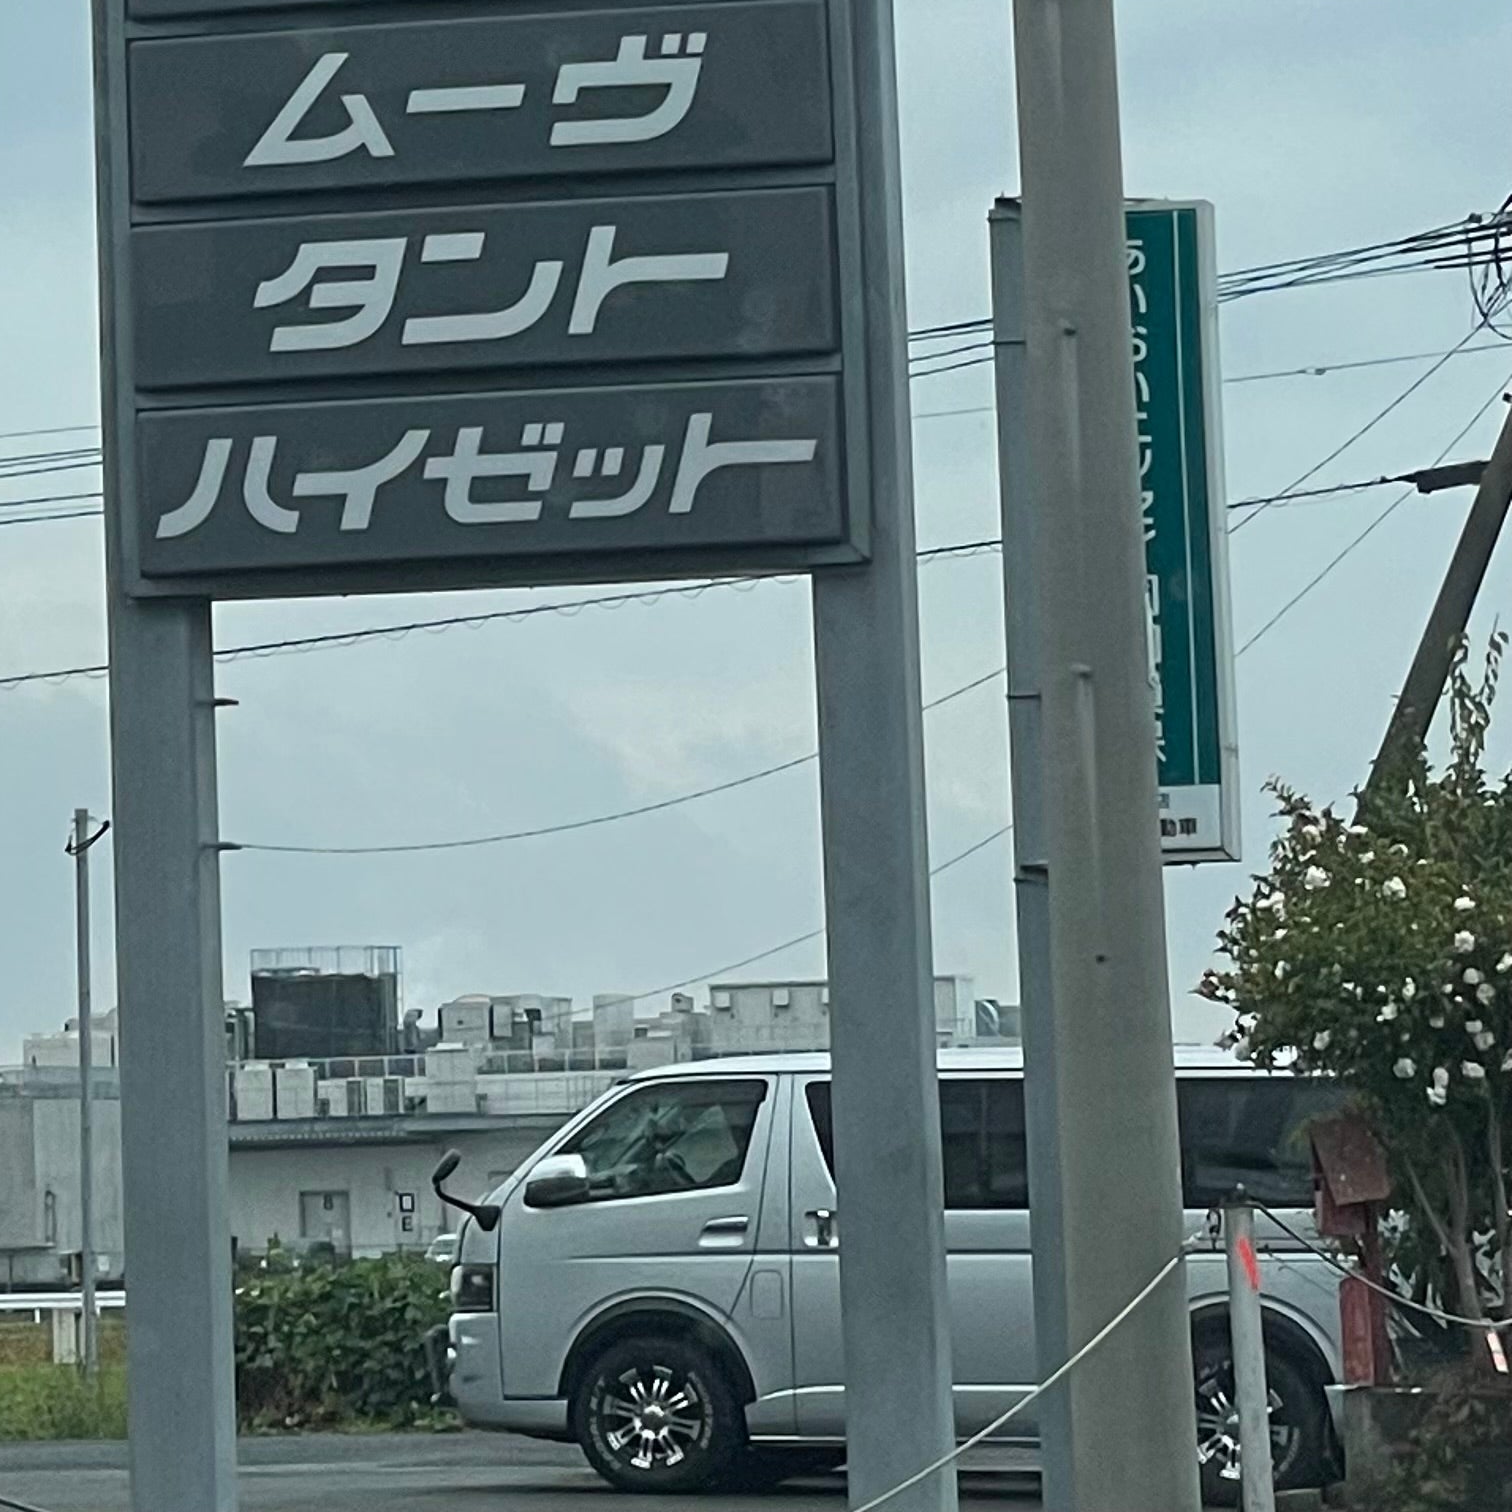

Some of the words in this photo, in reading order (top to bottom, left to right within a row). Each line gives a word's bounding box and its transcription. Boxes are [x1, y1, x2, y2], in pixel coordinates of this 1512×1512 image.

[242, 32, 708, 167] ムーヴ
[252, 224, 730, 352] タント
[155, 412, 818, 540] ハイゼット
